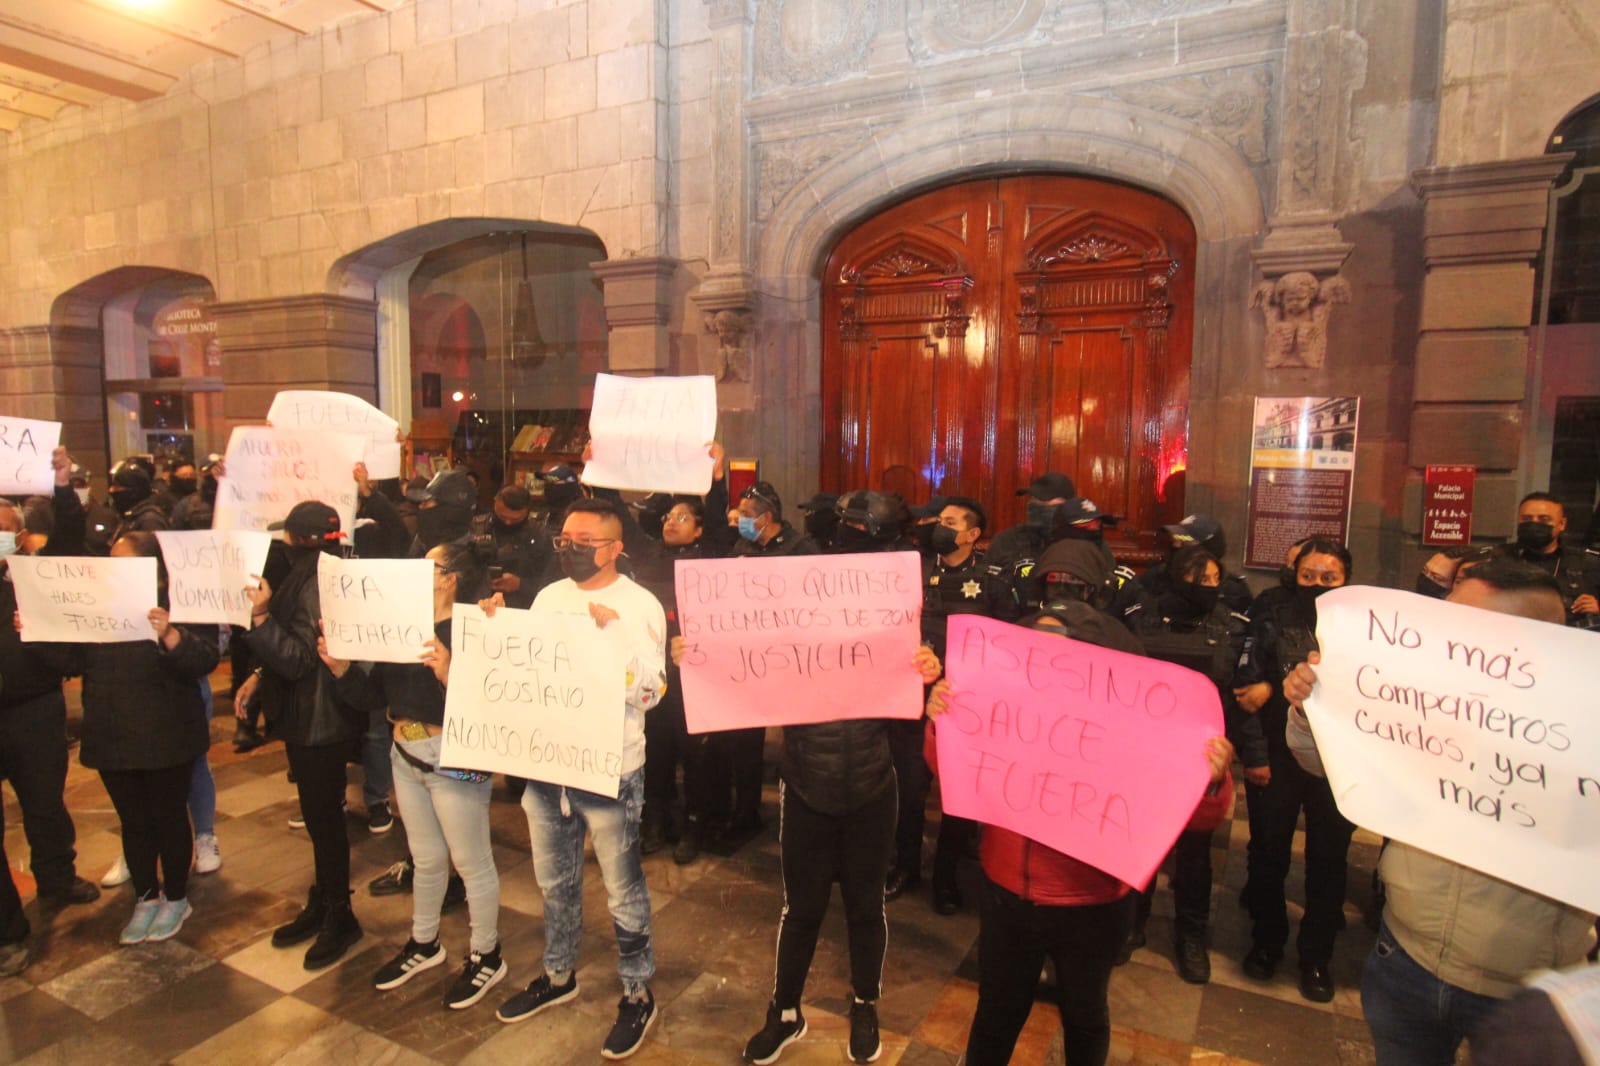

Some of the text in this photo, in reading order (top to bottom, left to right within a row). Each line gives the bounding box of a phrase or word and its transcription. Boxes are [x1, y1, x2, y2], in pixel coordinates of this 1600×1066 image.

[1433, 492, 1465, 500] Municipal
[1438, 484, 1461, 492] Palacio
[682, 566, 729, 605] POR
[62, 612, 138, 632] FUERA
[461, 615, 573, 673] FUERA
[730, 641, 873, 683] JUSTICIA
[962, 626, 1177, 718] ASESINO
[1368, 608, 1536, 690] No más
[483, 667, 584, 709] GUSTAVO
[1356, 664, 1572, 752] Compañeros
[952, 690, 1107, 762] SAUCE
[1489, 752, 1547, 790] ya
[968, 747, 1132, 844] FUERA
[1439, 777, 1537, 828] más
